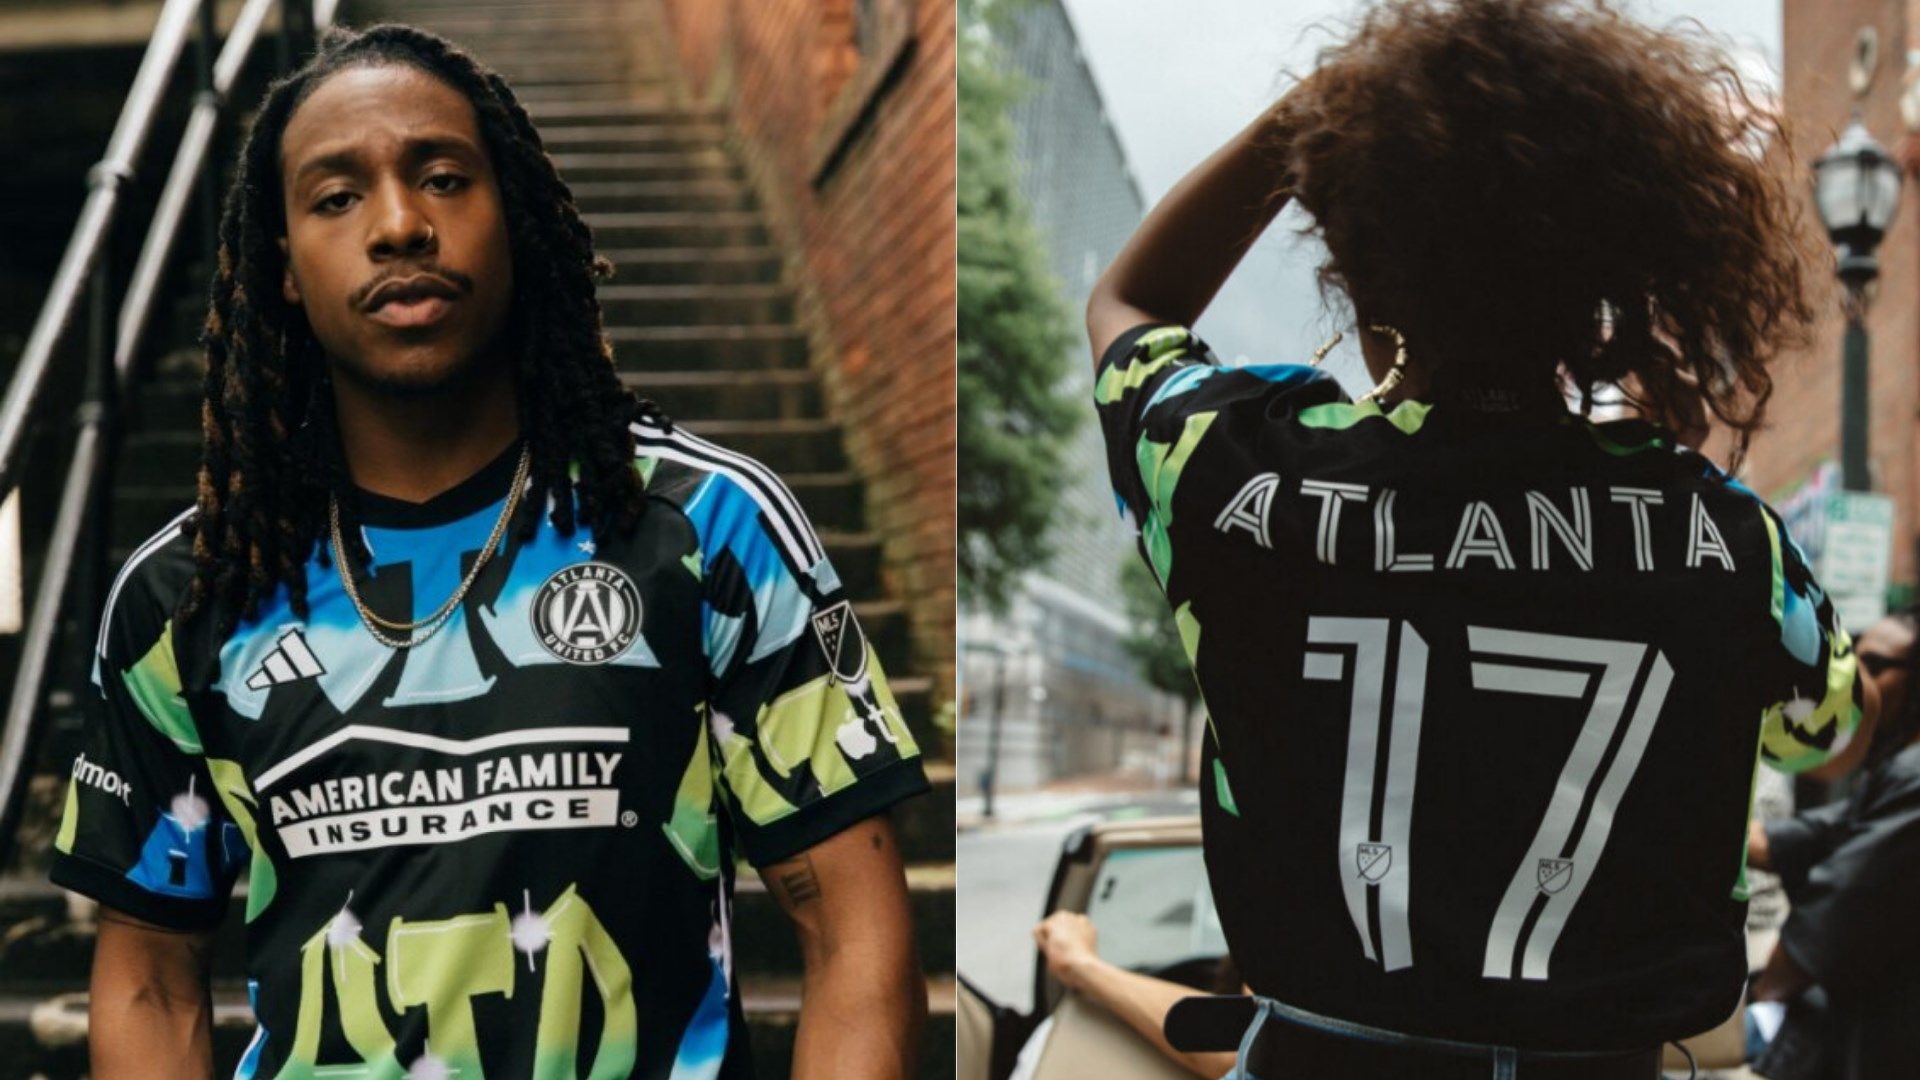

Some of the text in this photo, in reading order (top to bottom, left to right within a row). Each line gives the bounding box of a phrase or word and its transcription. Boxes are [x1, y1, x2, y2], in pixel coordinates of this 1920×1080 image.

[1213, 472, 1736, 572] ATLANTA
[550, 566, 625, 592] ATLANTA
[544, 632, 629, 661] UNITED FC
[816, 612, 840, 634] MLS
[270, 752, 622, 826] AMERICAN FAMILY
[1303, 615, 1676, 980] 17
[308, 798, 590, 846] INSURANCE
